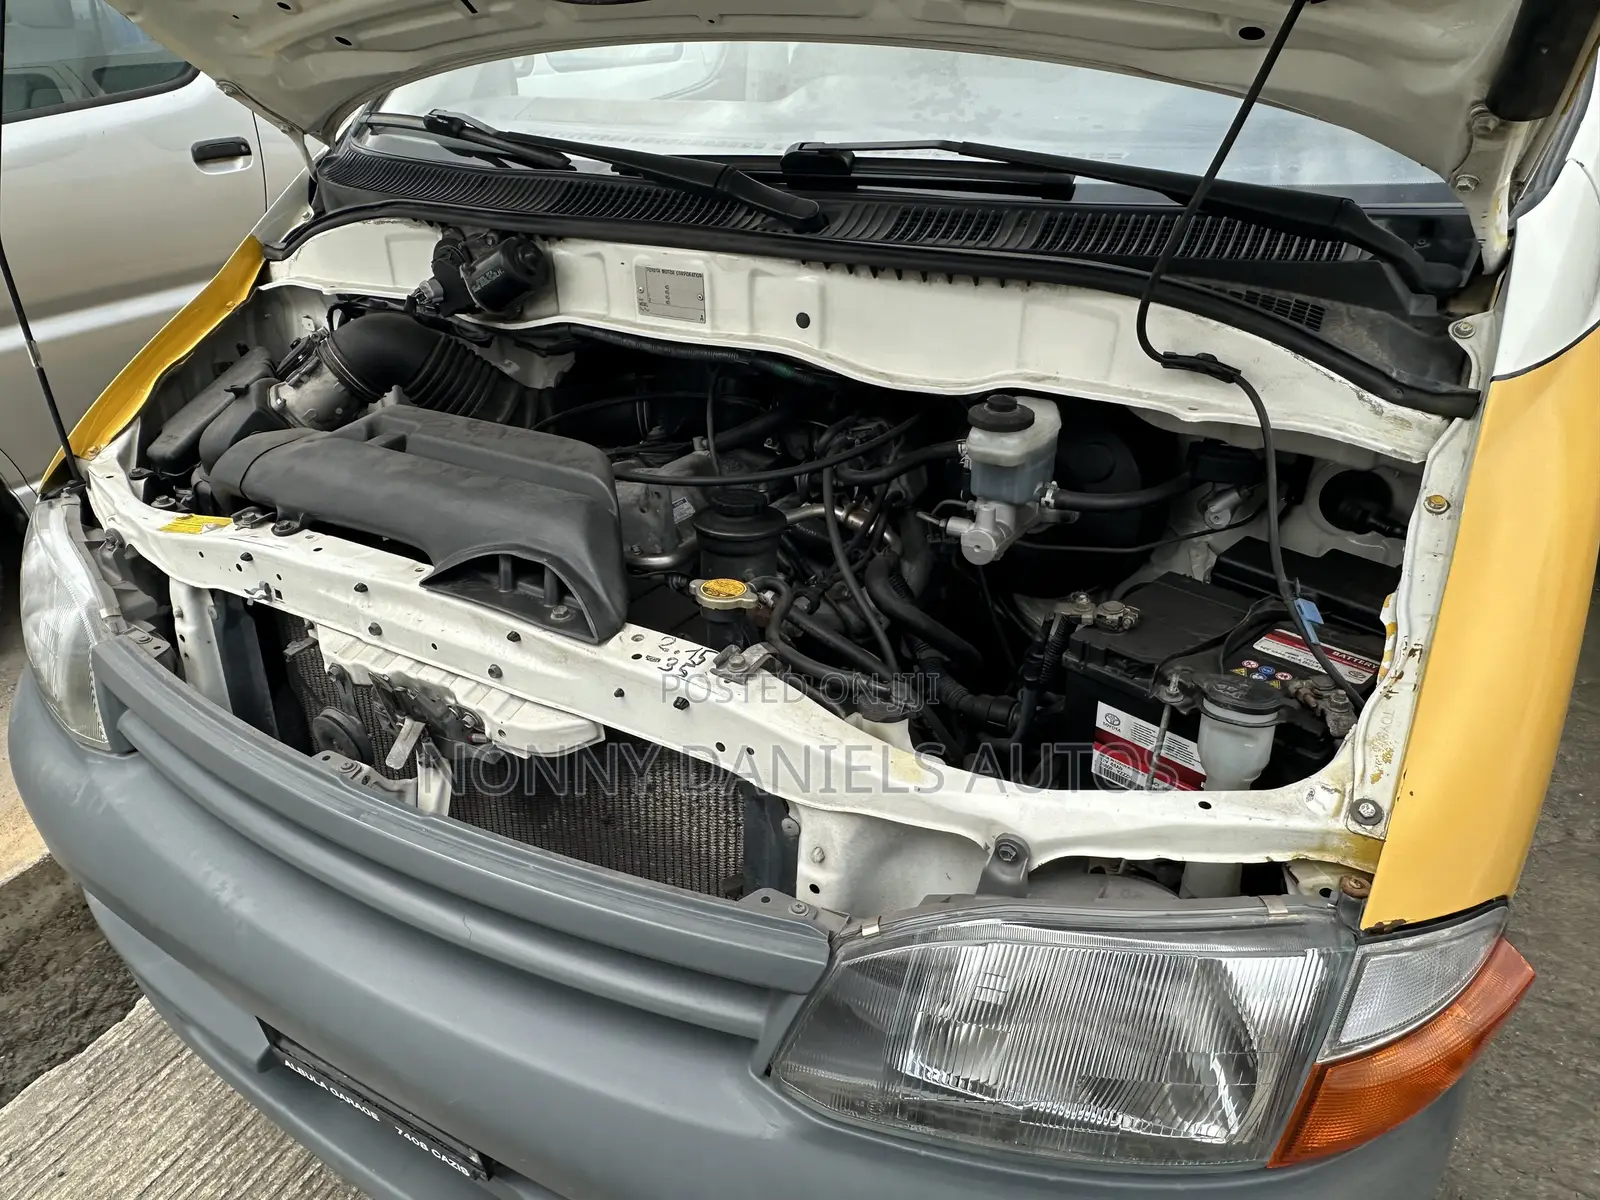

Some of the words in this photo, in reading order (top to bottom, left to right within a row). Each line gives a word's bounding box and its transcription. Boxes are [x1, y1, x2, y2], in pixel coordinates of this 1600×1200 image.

[1332, 651, 1379, 669] BATTERY
[1102, 721, 1121, 733] TOYOTA
[330, 1087, 380, 1122] GARAGE
